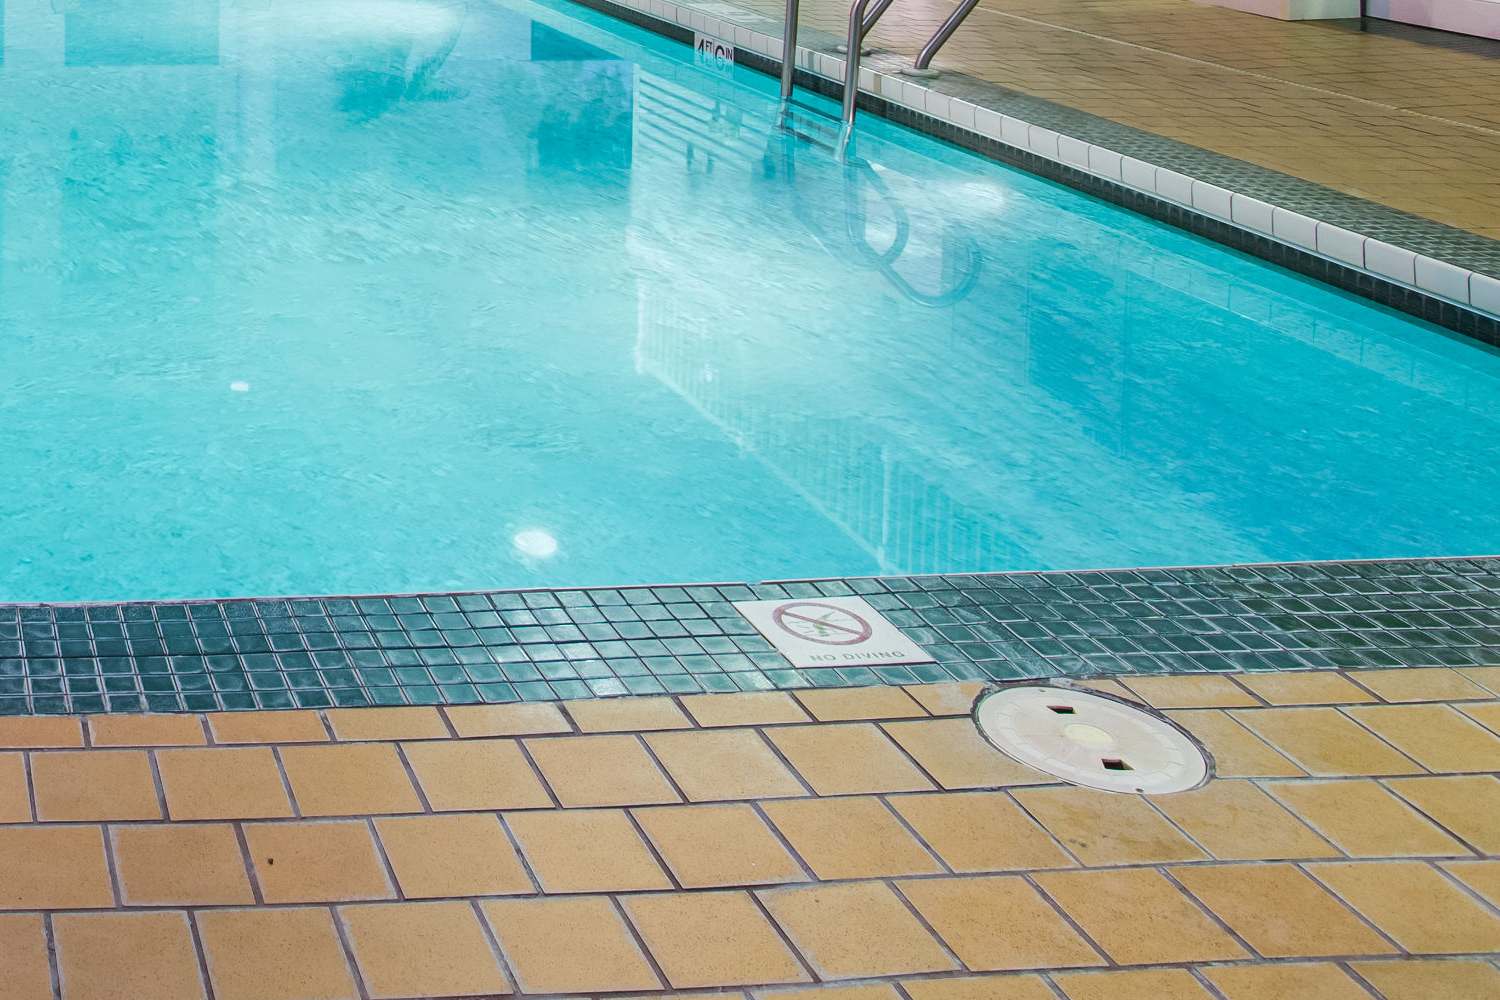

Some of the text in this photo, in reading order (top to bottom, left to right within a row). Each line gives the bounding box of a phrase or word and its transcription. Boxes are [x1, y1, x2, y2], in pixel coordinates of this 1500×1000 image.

[705, 40, 712, 53] FT
[809, 650, 906, 662] NO DIVING
